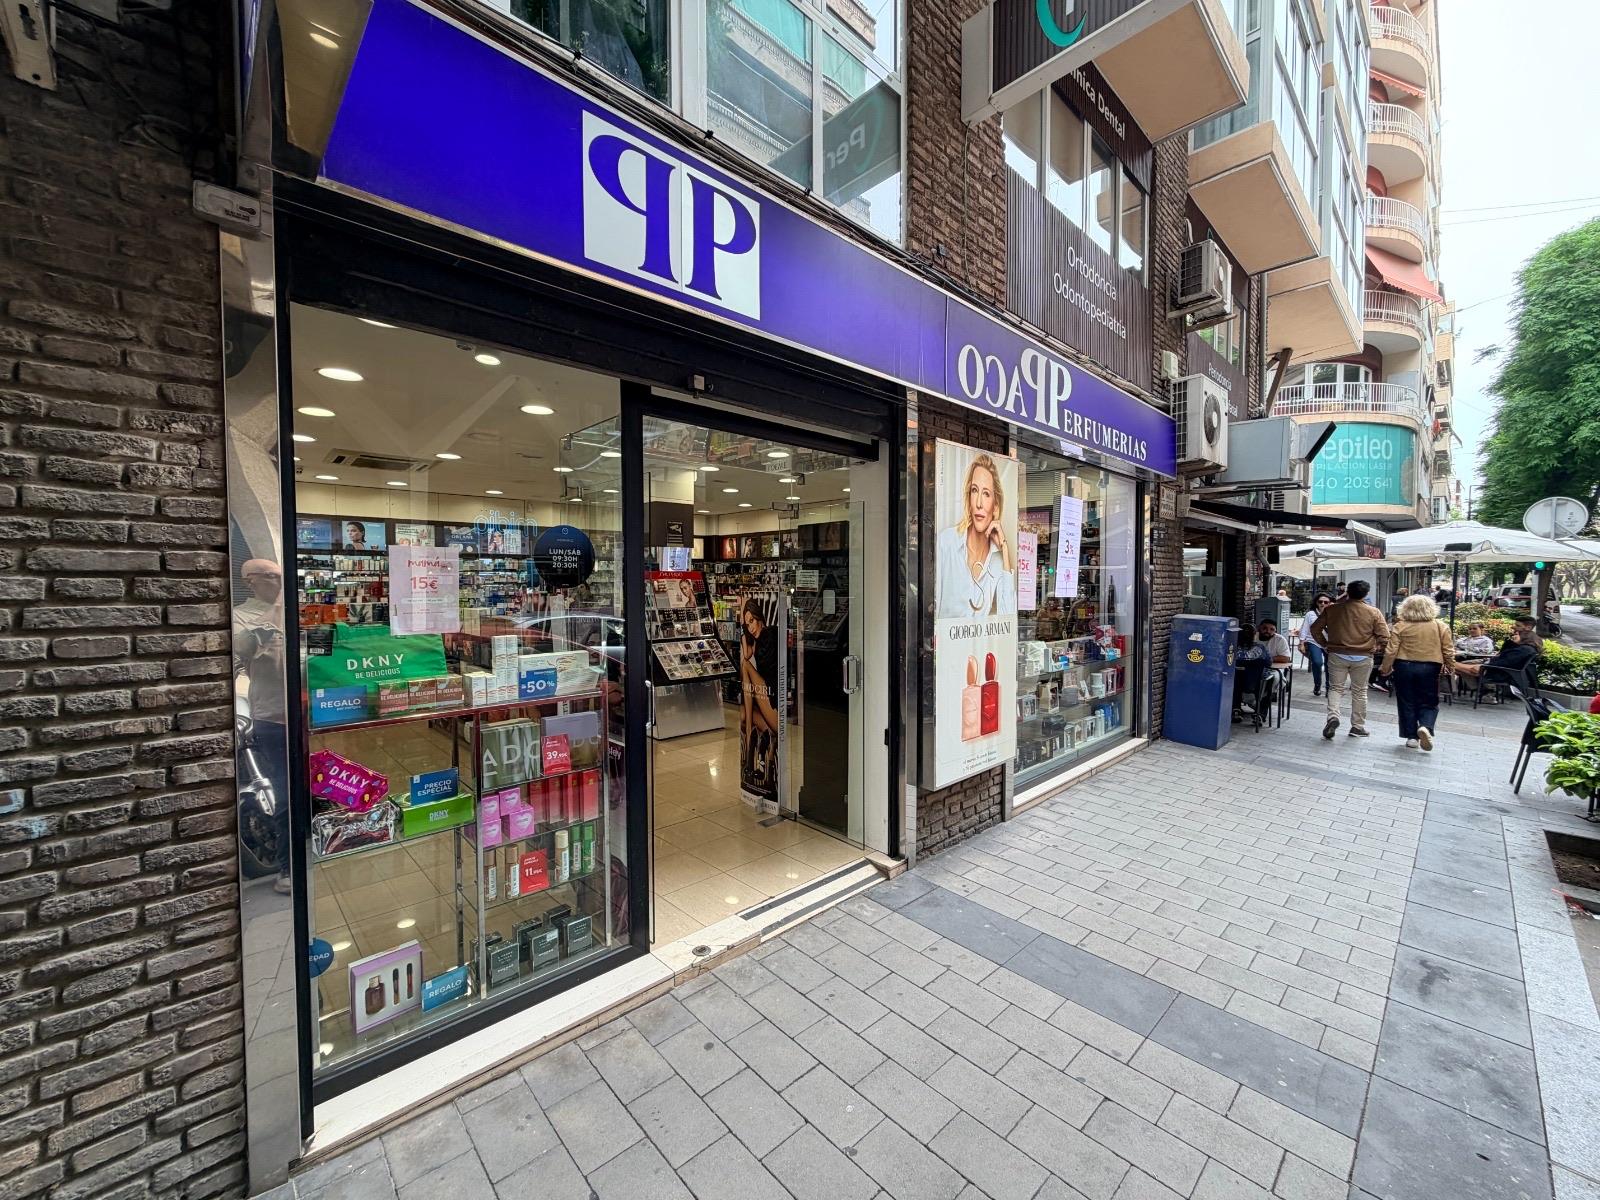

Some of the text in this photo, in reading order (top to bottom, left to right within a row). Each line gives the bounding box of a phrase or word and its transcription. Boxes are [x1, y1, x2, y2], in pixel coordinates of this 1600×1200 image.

[1098, 91, 1126, 141] Dental
[1067, 246, 1117, 301] Ortodoncia
[1314, 477, 1393, 489] 40 203 641
[410, 576, 438, 590] 15€
[949, 621, 1011, 640] GIORGIO ARMANI
[346, 653, 405, 671] DKNY
[355, 667, 401, 679] BE DELICIOUS
[521, 679, 555, 693] -50%
[320, 698, 361, 709] REGALO
[328, 765, 370, 788] DKNY
[328, 778, 359, 795] BE DELICIOUS
[417, 786, 453, 797] ESPECIAL
[424, 779, 452, 790] PRECIO
[309, 952, 330, 962] EDAD
[428, 979, 462, 999] REGALO
